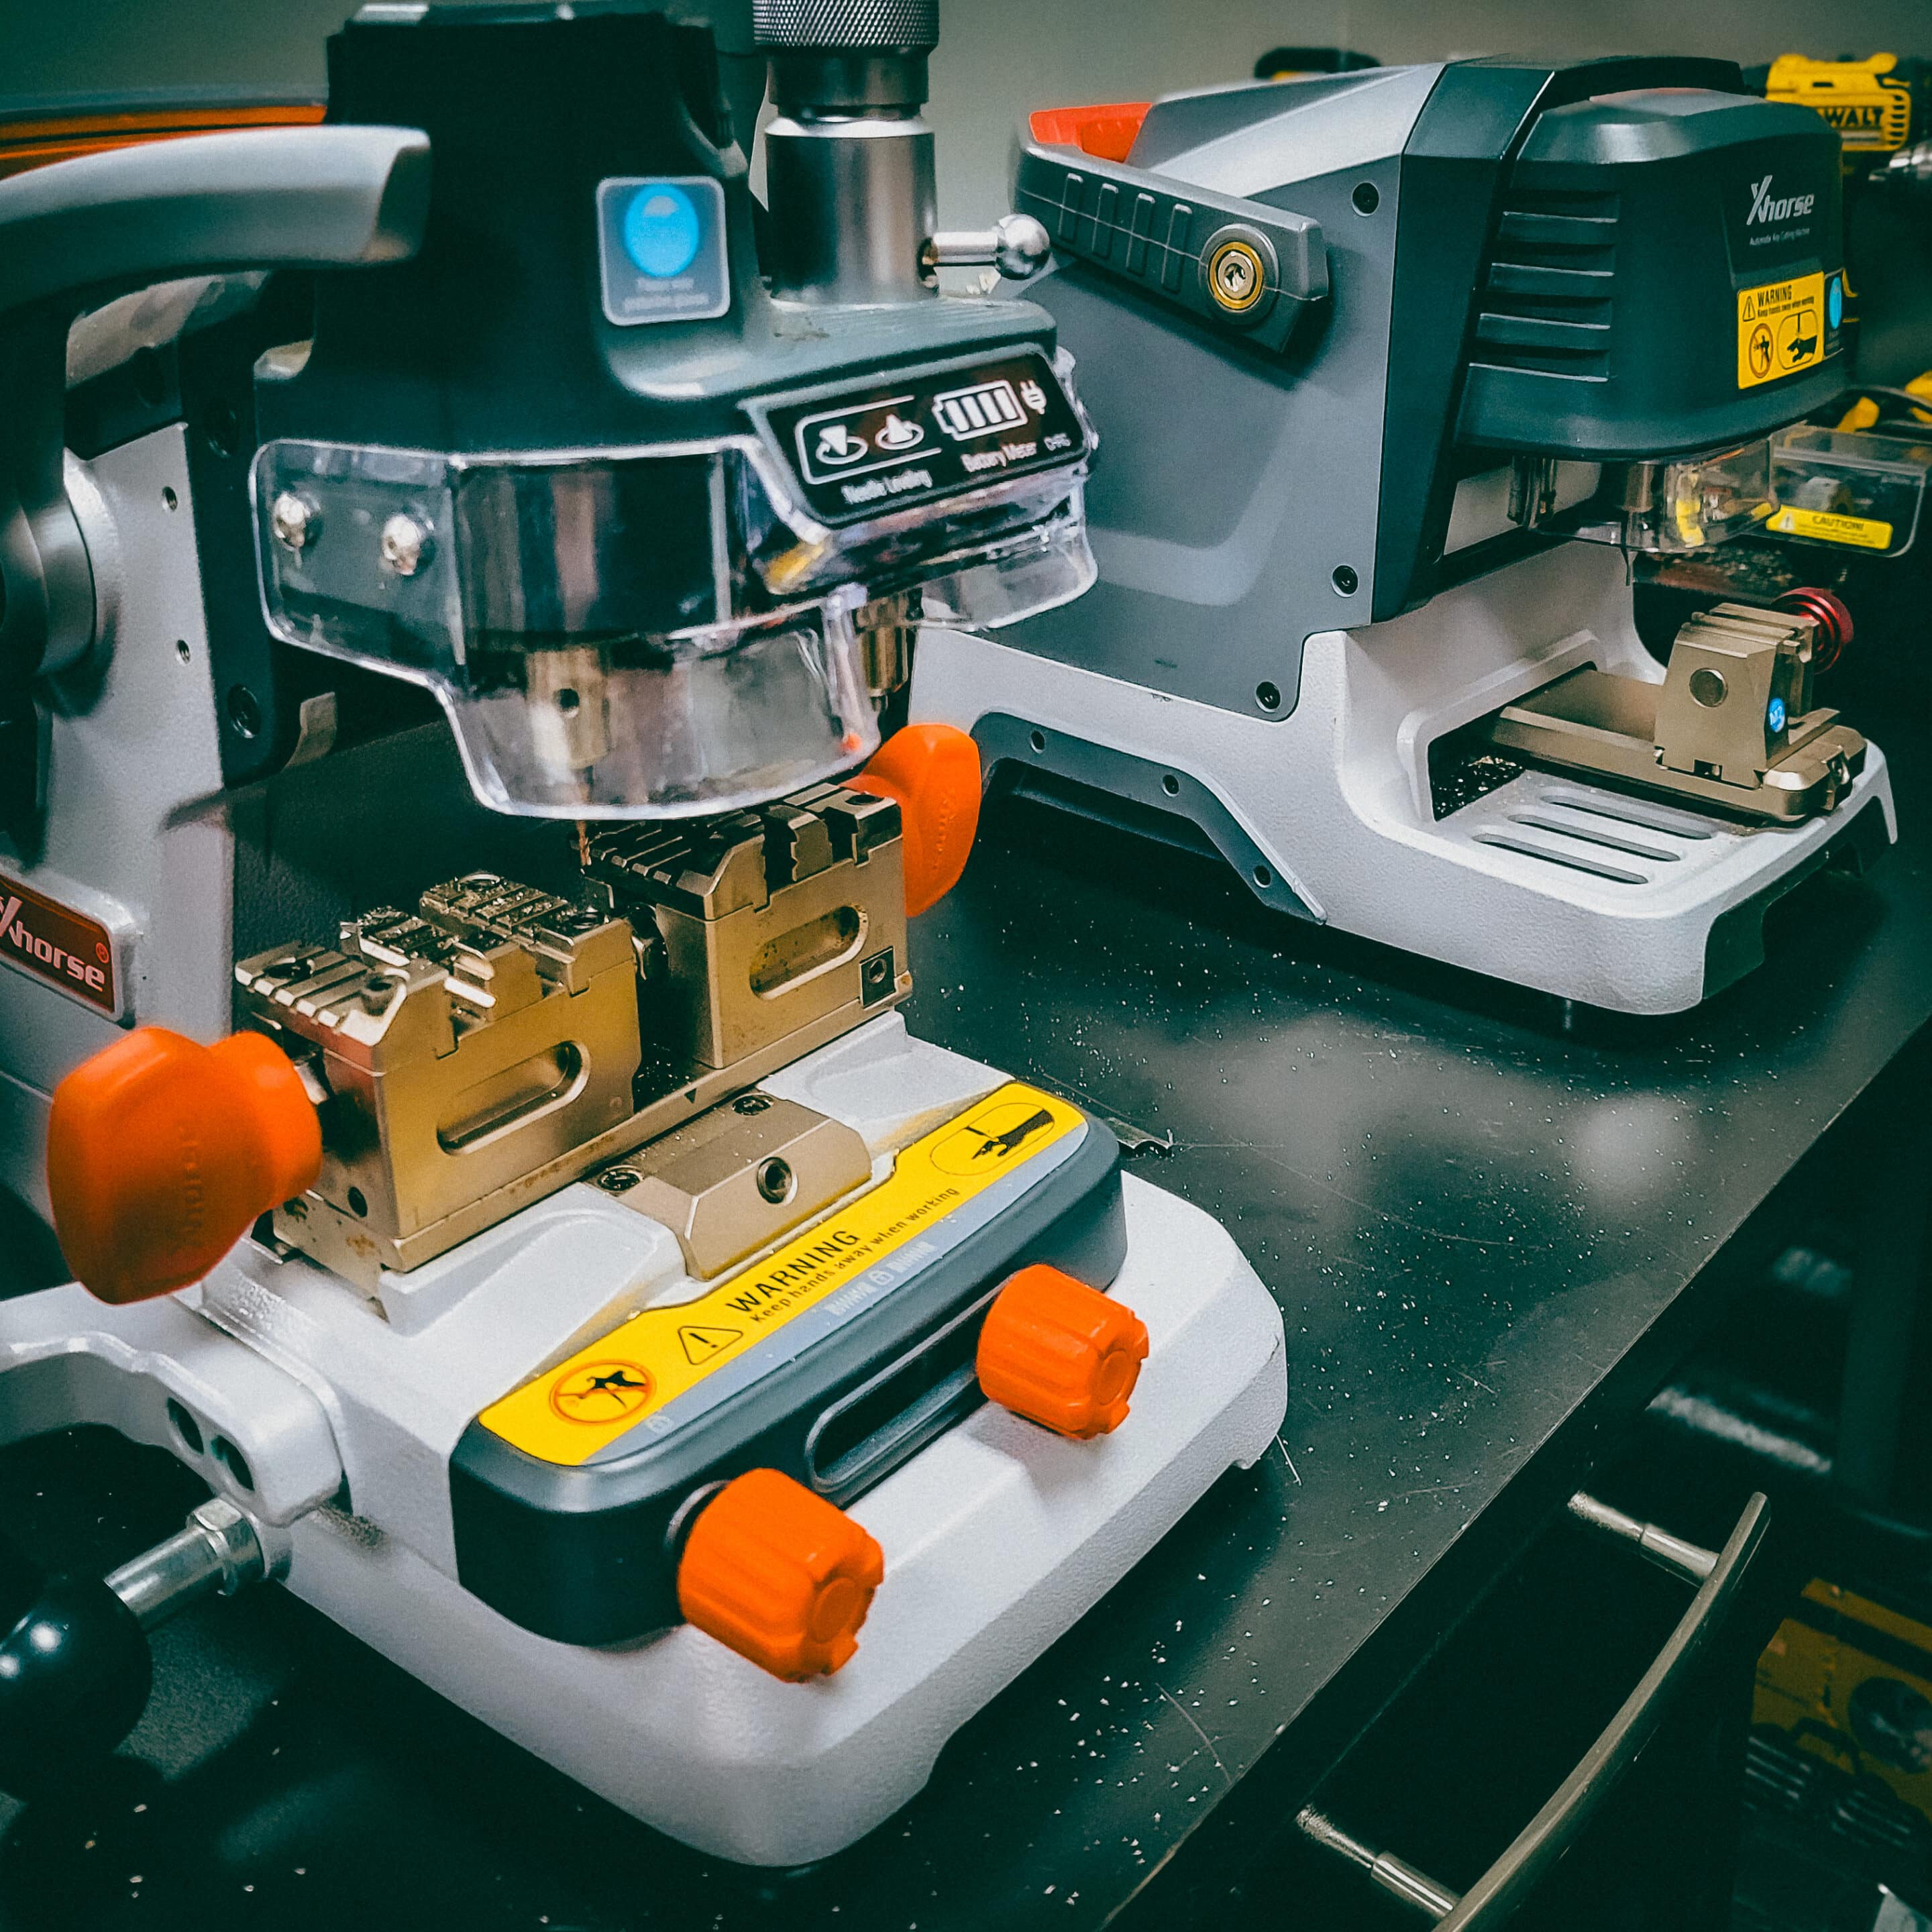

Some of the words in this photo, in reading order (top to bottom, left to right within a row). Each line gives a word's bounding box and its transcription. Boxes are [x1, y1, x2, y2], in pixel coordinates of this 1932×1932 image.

[1823, 106, 1884, 127] WALT
[1746, 174, 1815, 225] Xhorse
[1757, 284, 1792, 307] WARNING
[725, 1230, 861, 1313] WARNING
[750, 1299, 792, 1323] Keep
[789, 1269, 837, 1298] hands
[834, 1244, 873, 1271] away
[870, 1222, 908, 1245] when
[906, 1187, 960, 1221] working
